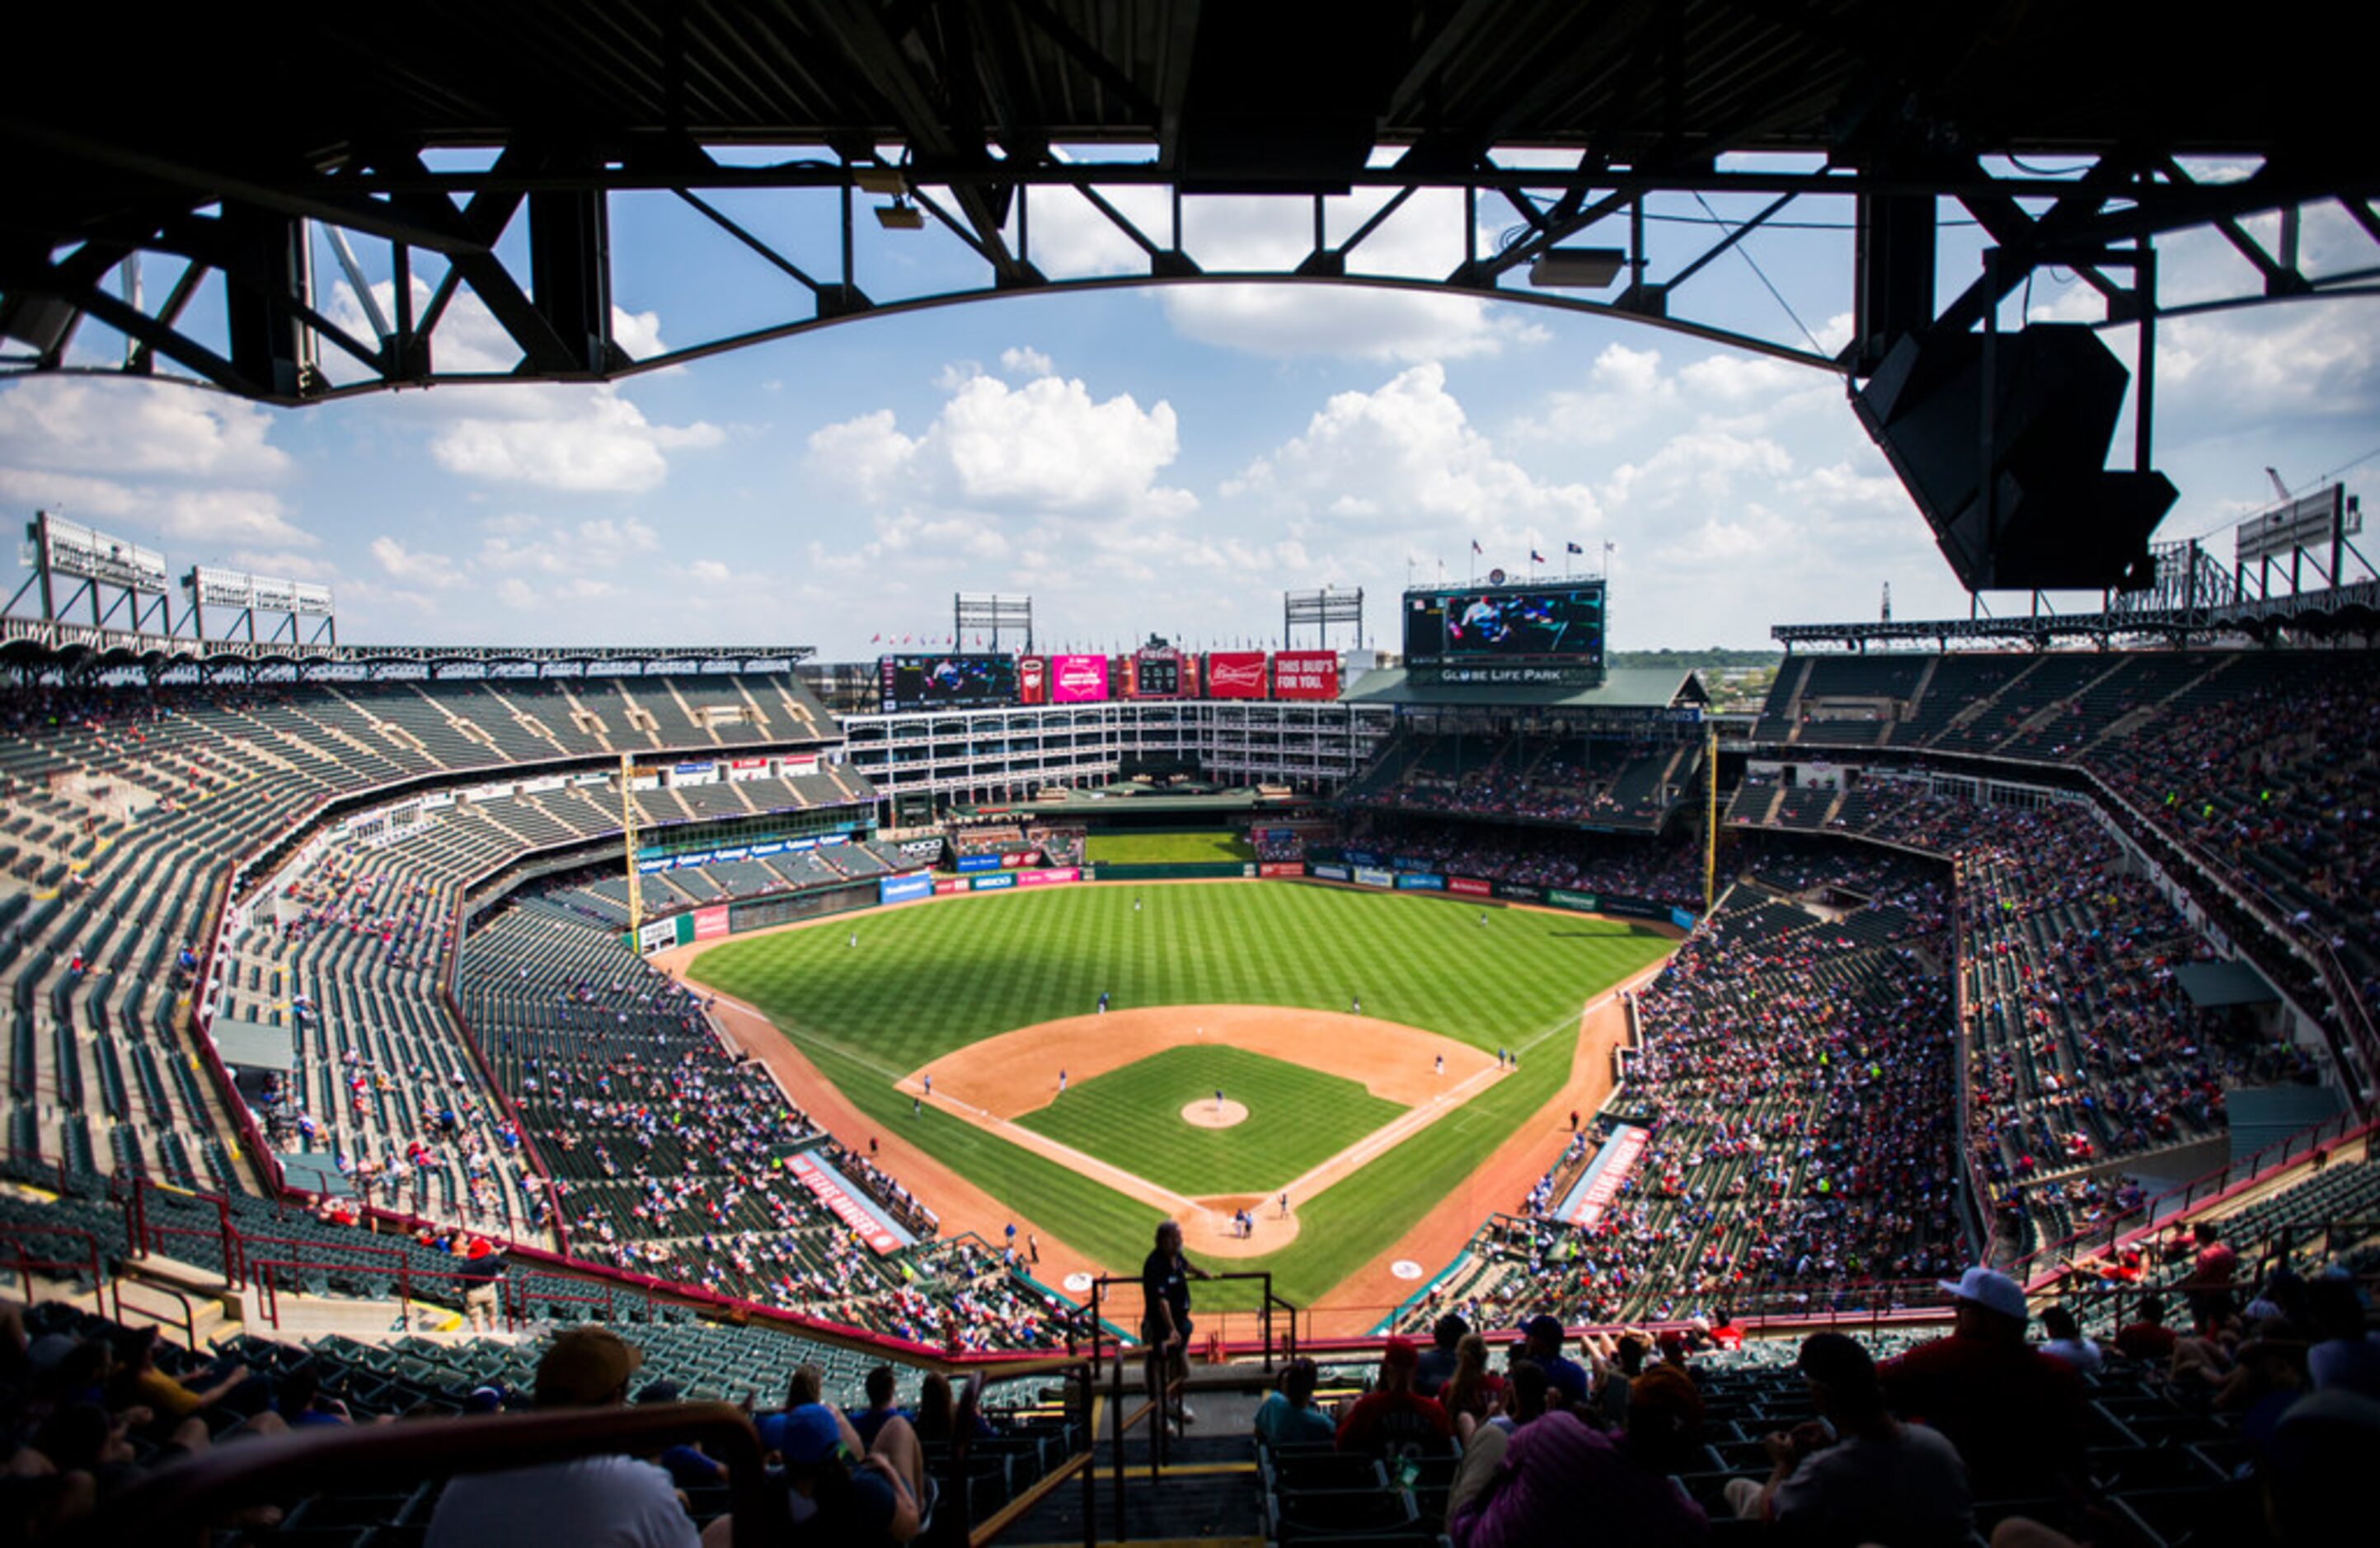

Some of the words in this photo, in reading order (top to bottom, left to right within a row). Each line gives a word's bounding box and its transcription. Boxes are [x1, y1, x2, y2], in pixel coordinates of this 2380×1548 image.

[1278, 659, 1300, 673] THIS
[1303, 659, 1334, 673] BUD'S
[1441, 668, 1487, 682] GLOBE
[1490, 668, 1522, 682] LIFE
[1523, 668, 1561, 682] PARK
[1278, 676, 1298, 689] FOR
[1300, 676, 1323, 689] YOU.
[802, 1171, 841, 1198] TEXAS
[829, 1196, 881, 1236] RANGERS
